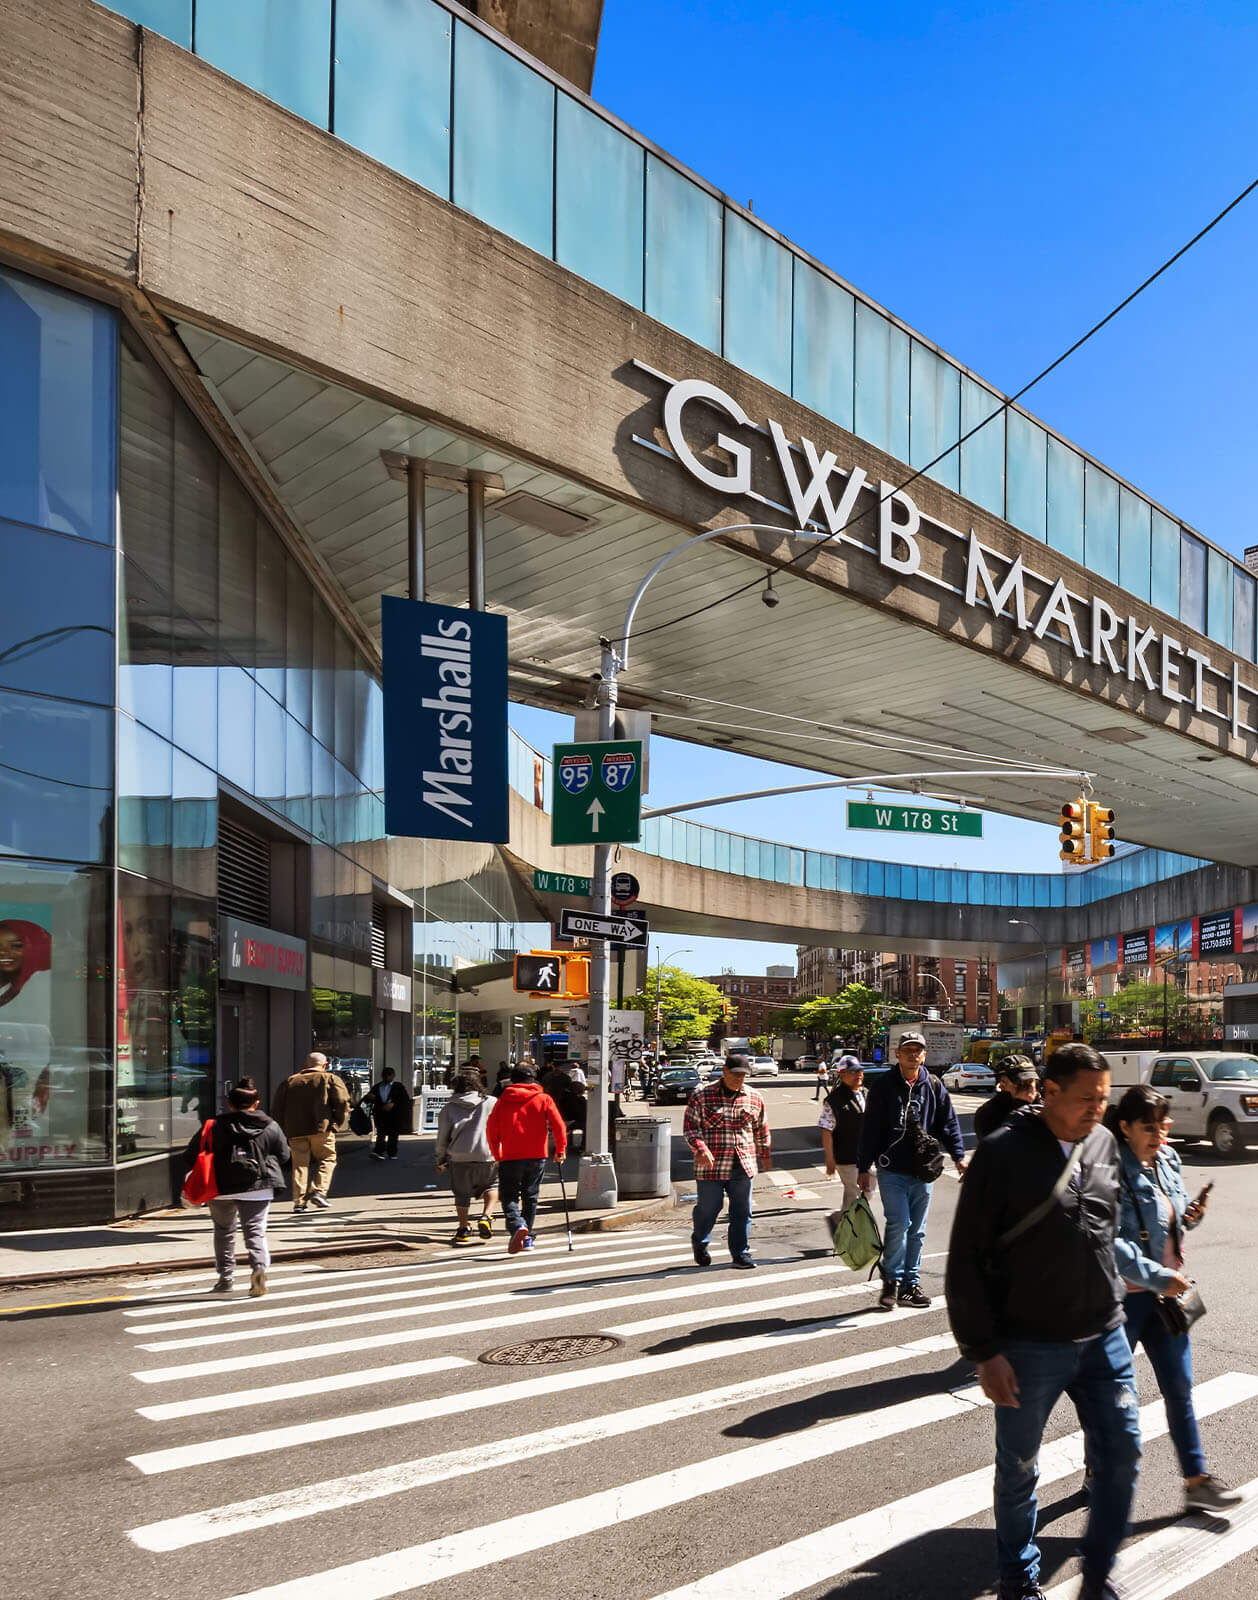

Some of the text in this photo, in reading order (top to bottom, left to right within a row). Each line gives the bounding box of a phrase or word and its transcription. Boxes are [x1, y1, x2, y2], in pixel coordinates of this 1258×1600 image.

[664, 379, 921, 576] GWB
[965, 528, 1211, 713] MARKET
[420, 619, 473, 828] Marshalls
[562, 765, 632, 788] 95 87
[875, 809, 958, 831] W 178 St
[538, 873, 549, 889] W
[555, 877, 575, 893] 178
[575, 920, 635, 936] ONE WAY
[277, 946, 304, 977] SUPPLY
[1233, 1024, 1249, 1039] blink
